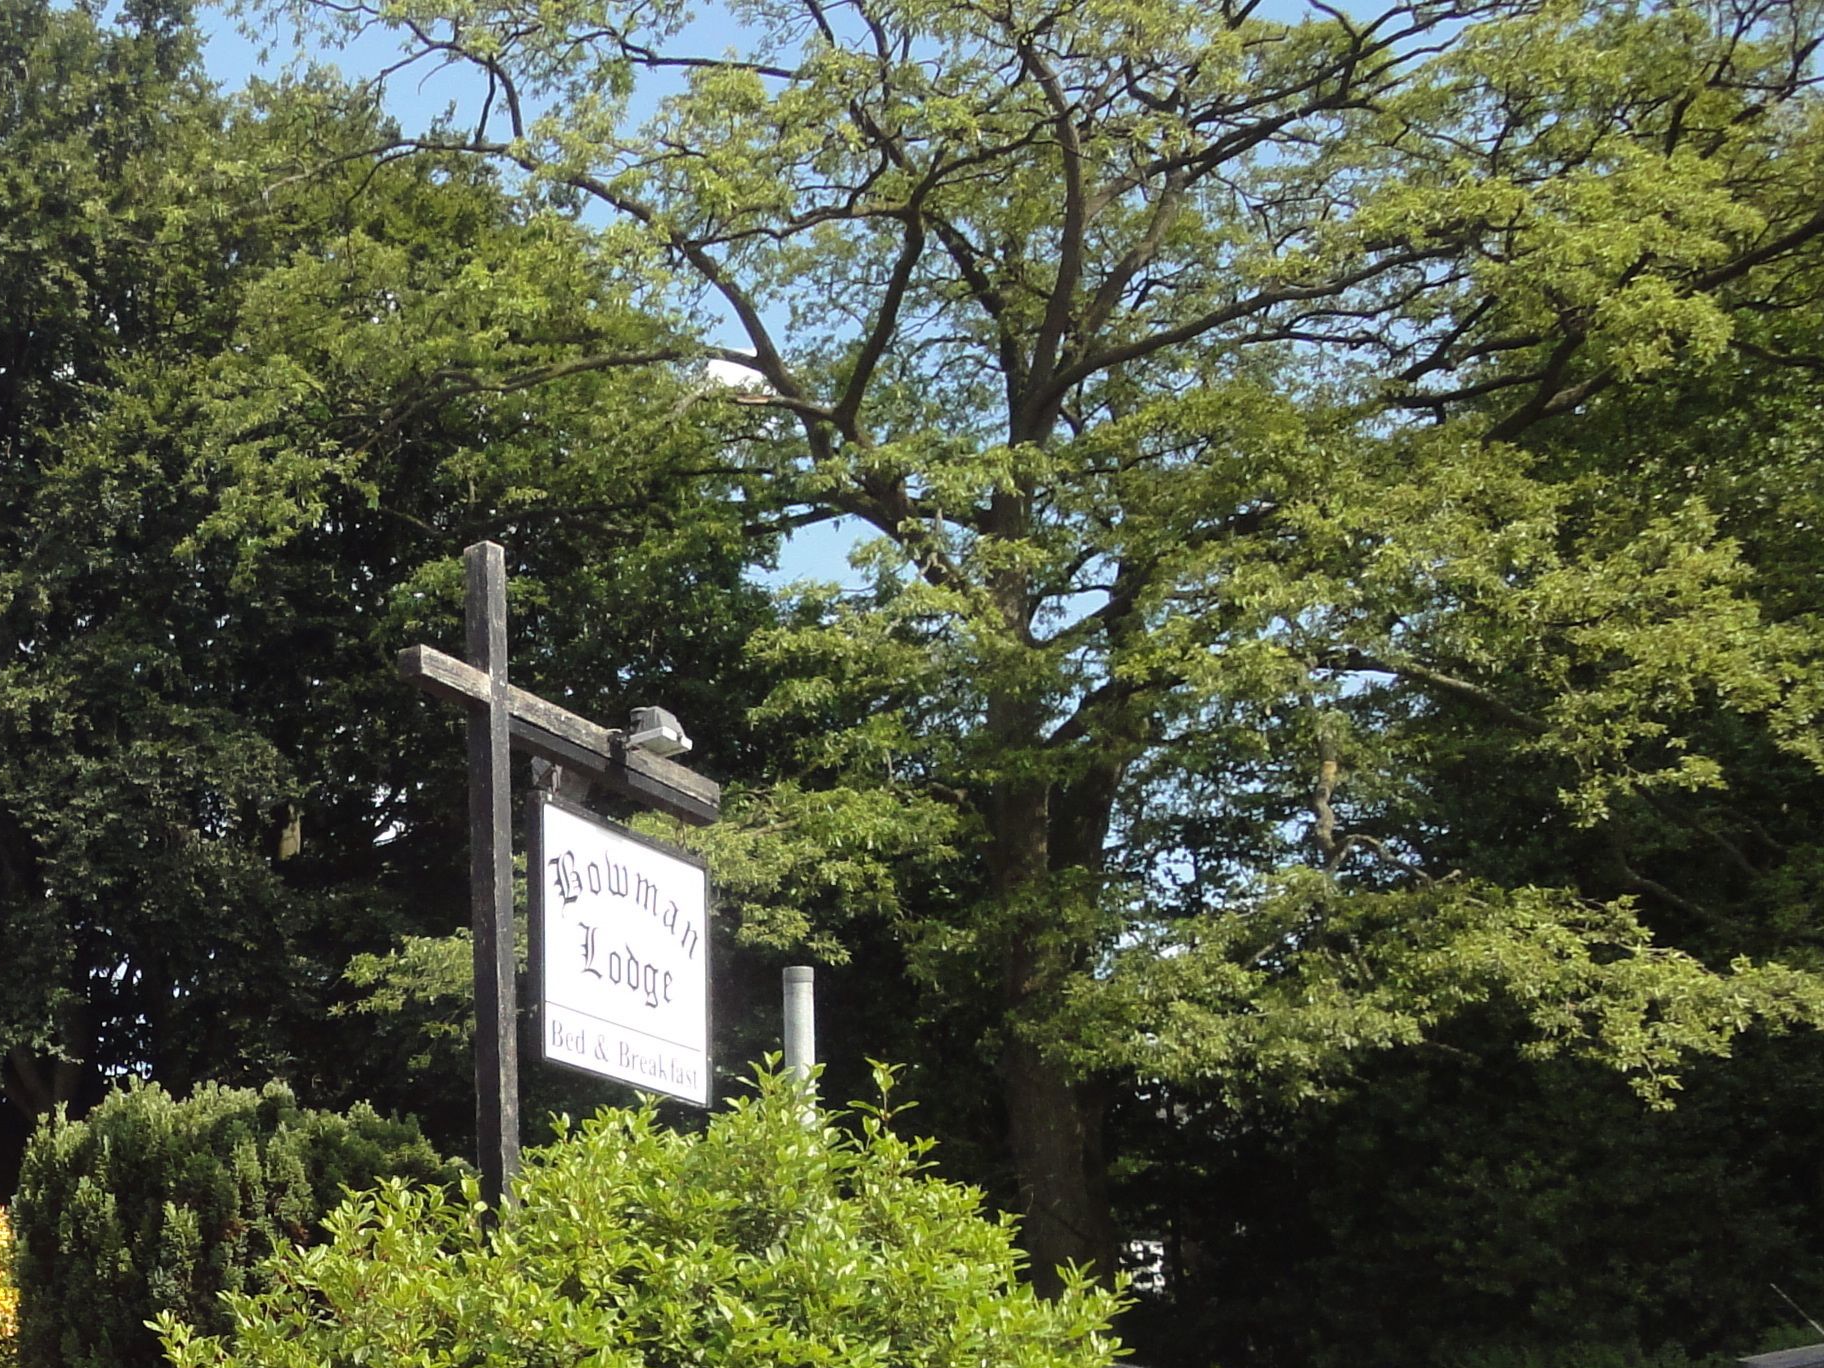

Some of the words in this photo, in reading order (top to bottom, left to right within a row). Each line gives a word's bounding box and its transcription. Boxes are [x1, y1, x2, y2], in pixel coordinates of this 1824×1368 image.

[548, 850, 699, 960] Bowman
[578, 921, 673, 1009] Lodge
[551, 1019, 586, 1055] Bed
[594, 1034, 609, 1063] &
[619, 1040, 698, 1090] Breakfast
